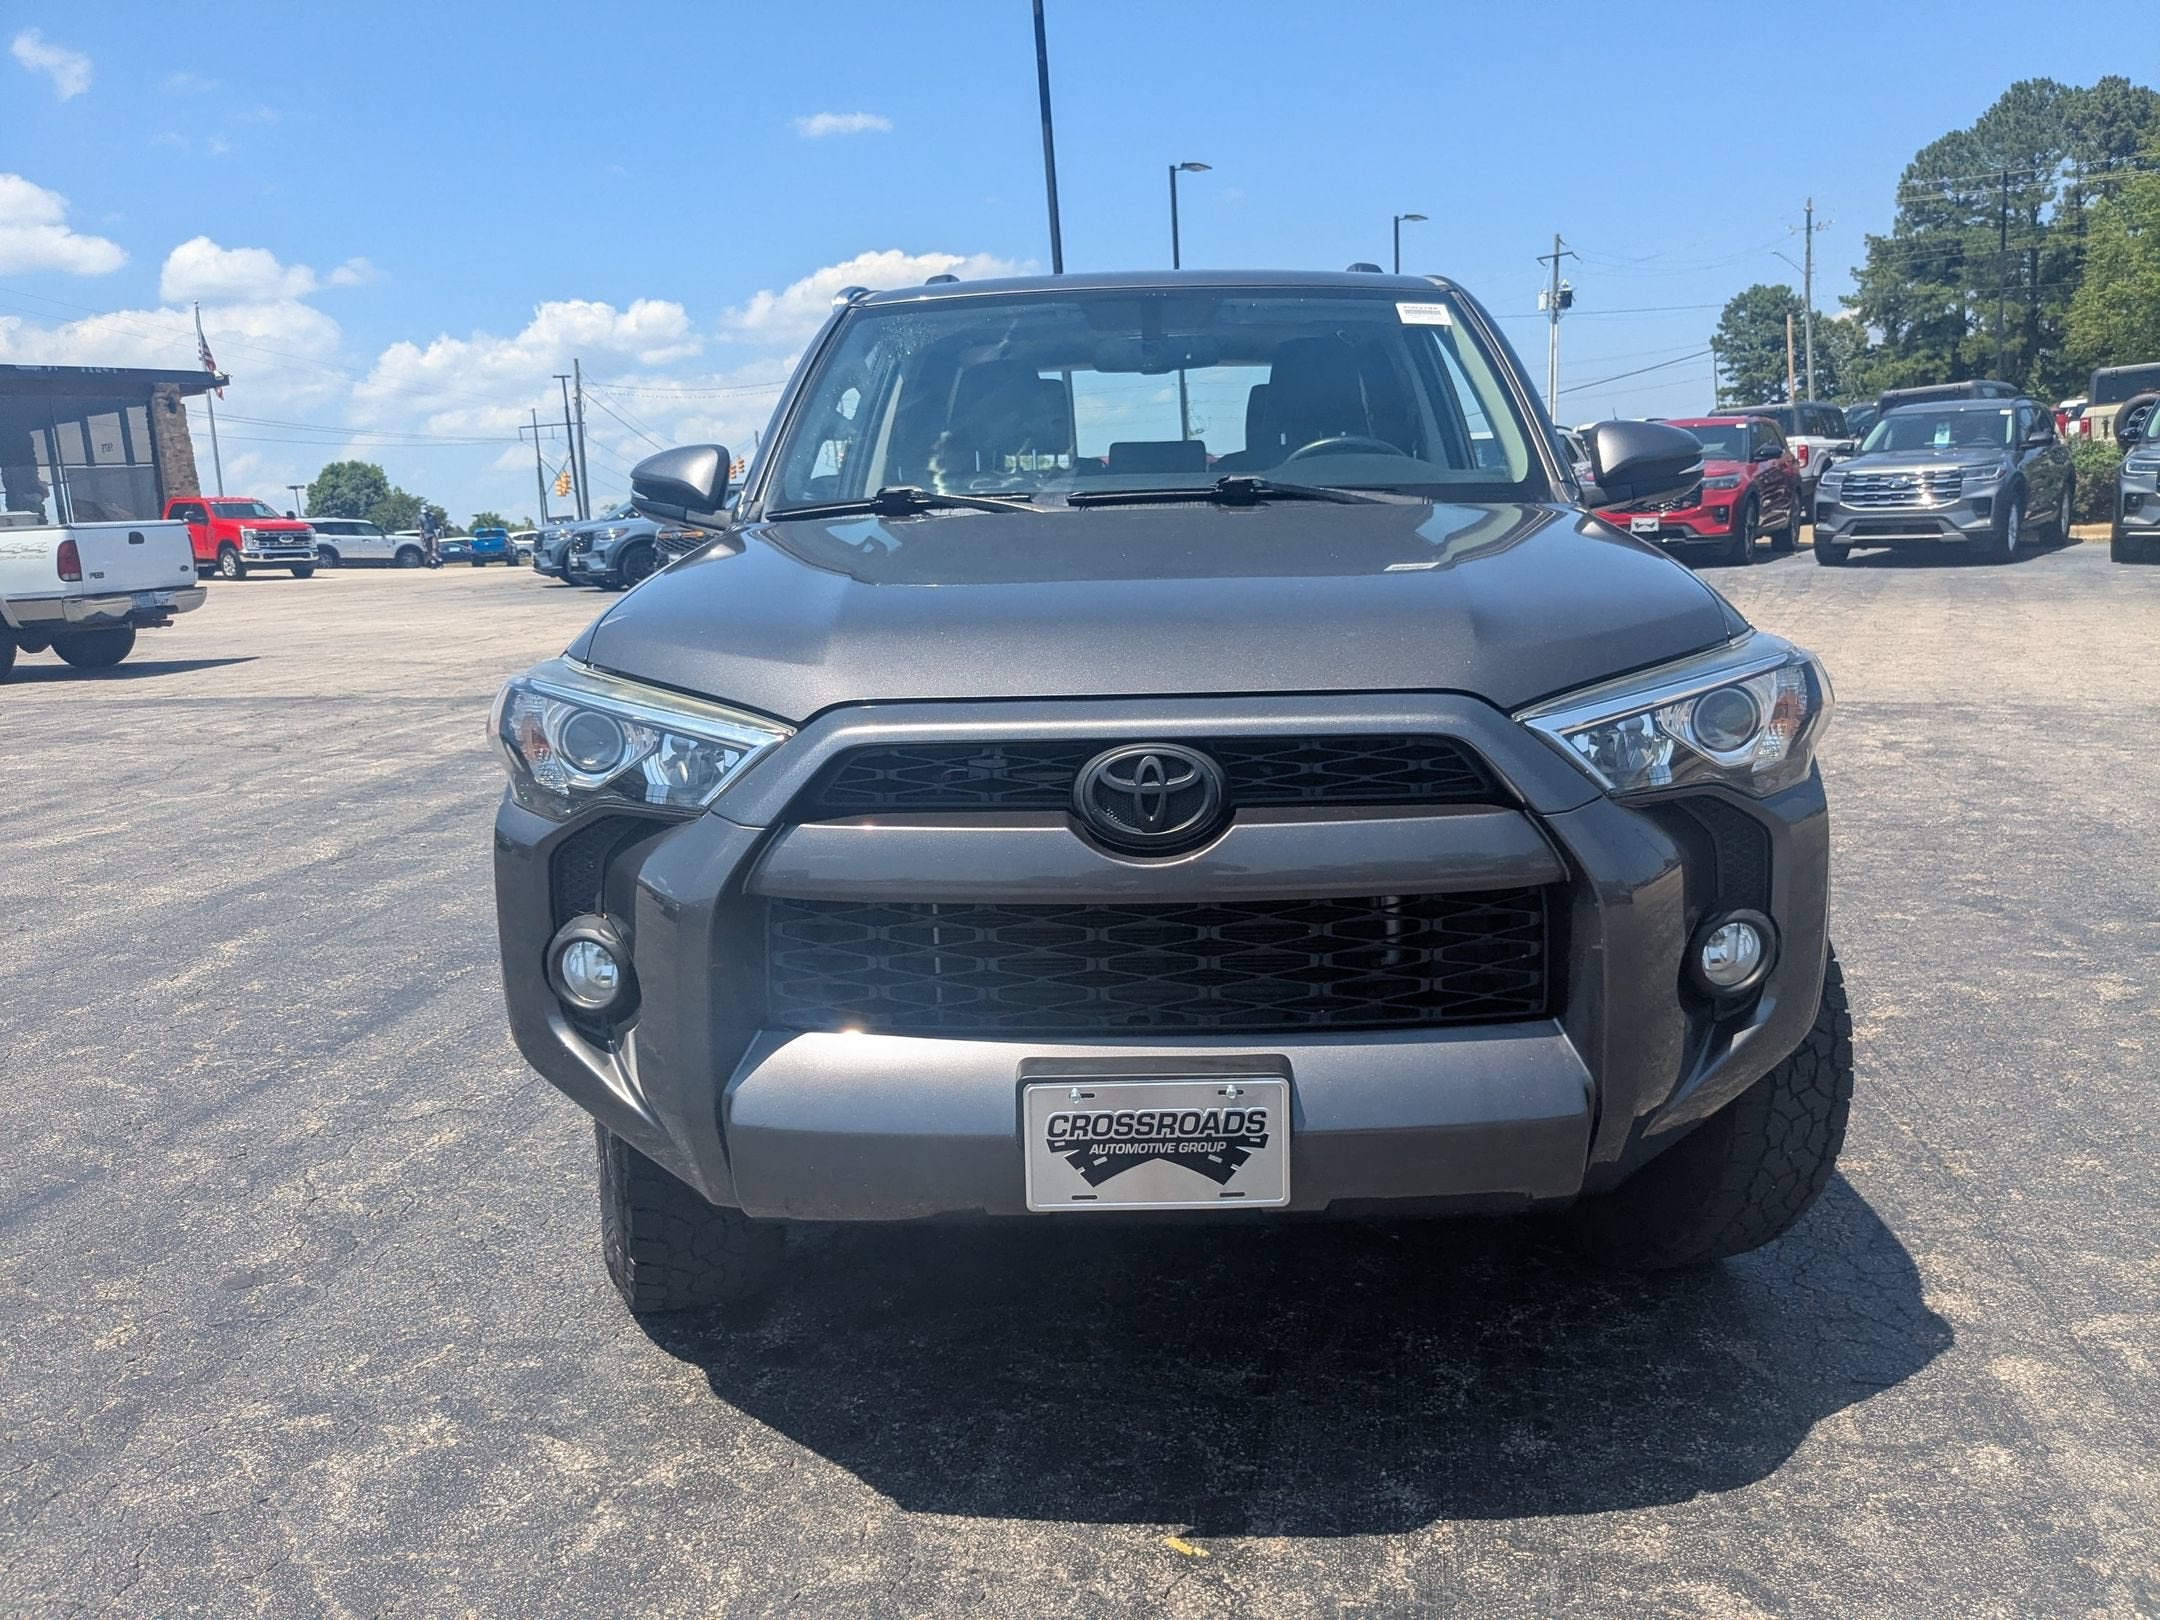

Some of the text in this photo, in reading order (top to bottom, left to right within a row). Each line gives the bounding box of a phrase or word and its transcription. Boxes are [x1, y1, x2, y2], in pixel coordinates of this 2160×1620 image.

[1047, 1110, 1267, 1138] CROSSROADS
[1089, 1141, 1227, 1155] AUTOMOTIVE GROUP
